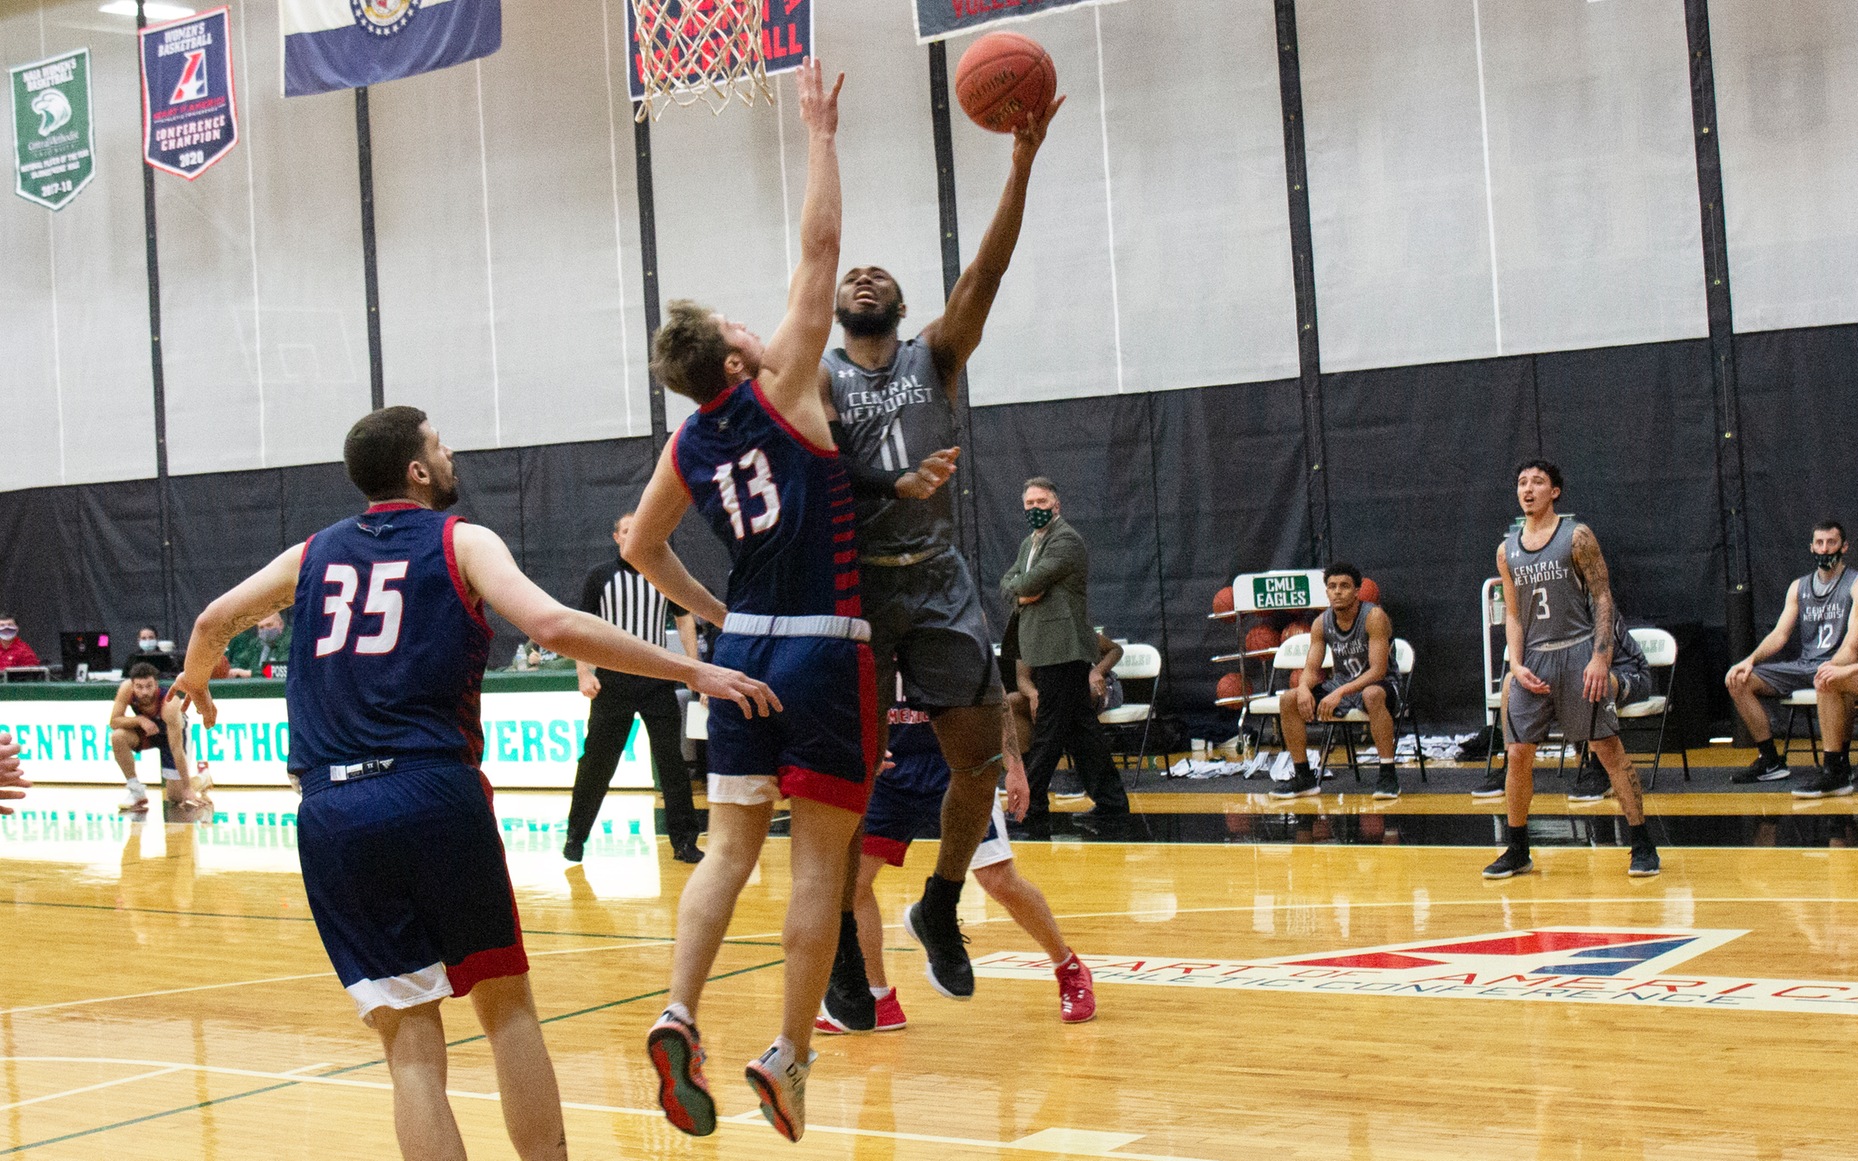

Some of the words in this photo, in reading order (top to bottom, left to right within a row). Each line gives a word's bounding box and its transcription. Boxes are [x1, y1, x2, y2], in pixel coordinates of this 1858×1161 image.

[164, 21, 205, 43] WOMEN'S
[158, 33, 213, 57] BASKETBALL
[155, 114, 226, 142] CONFERENCE
[161, 129, 221, 152] CHAMPION
[179, 149, 205, 168] 2020
[880, 417, 910, 472] 11
[712, 448, 781, 541] 13
[1514, 560, 1562, 577] CENTRAL
[1514, 568, 1569, 587] METHODIST
[1265, 577, 1295, 592] CMU
[315, 560, 410, 659] 35
[1256, 591, 1307, 608] EAGLES
[1532, 587, 1551, 620] 3
[1816, 624, 1833, 649] 12
[1343, 658, 1362, 678] 10
[0, 724, 142, 761] ENTRA
[191, 722, 290, 762] METHO
[977, 955, 1220, 977] HEART
[1288, 968, 1383, 979] OF
[1408, 972, 1858, 1001] AMERIC
[1313, 980, 1756, 1006] CONFERENCE
